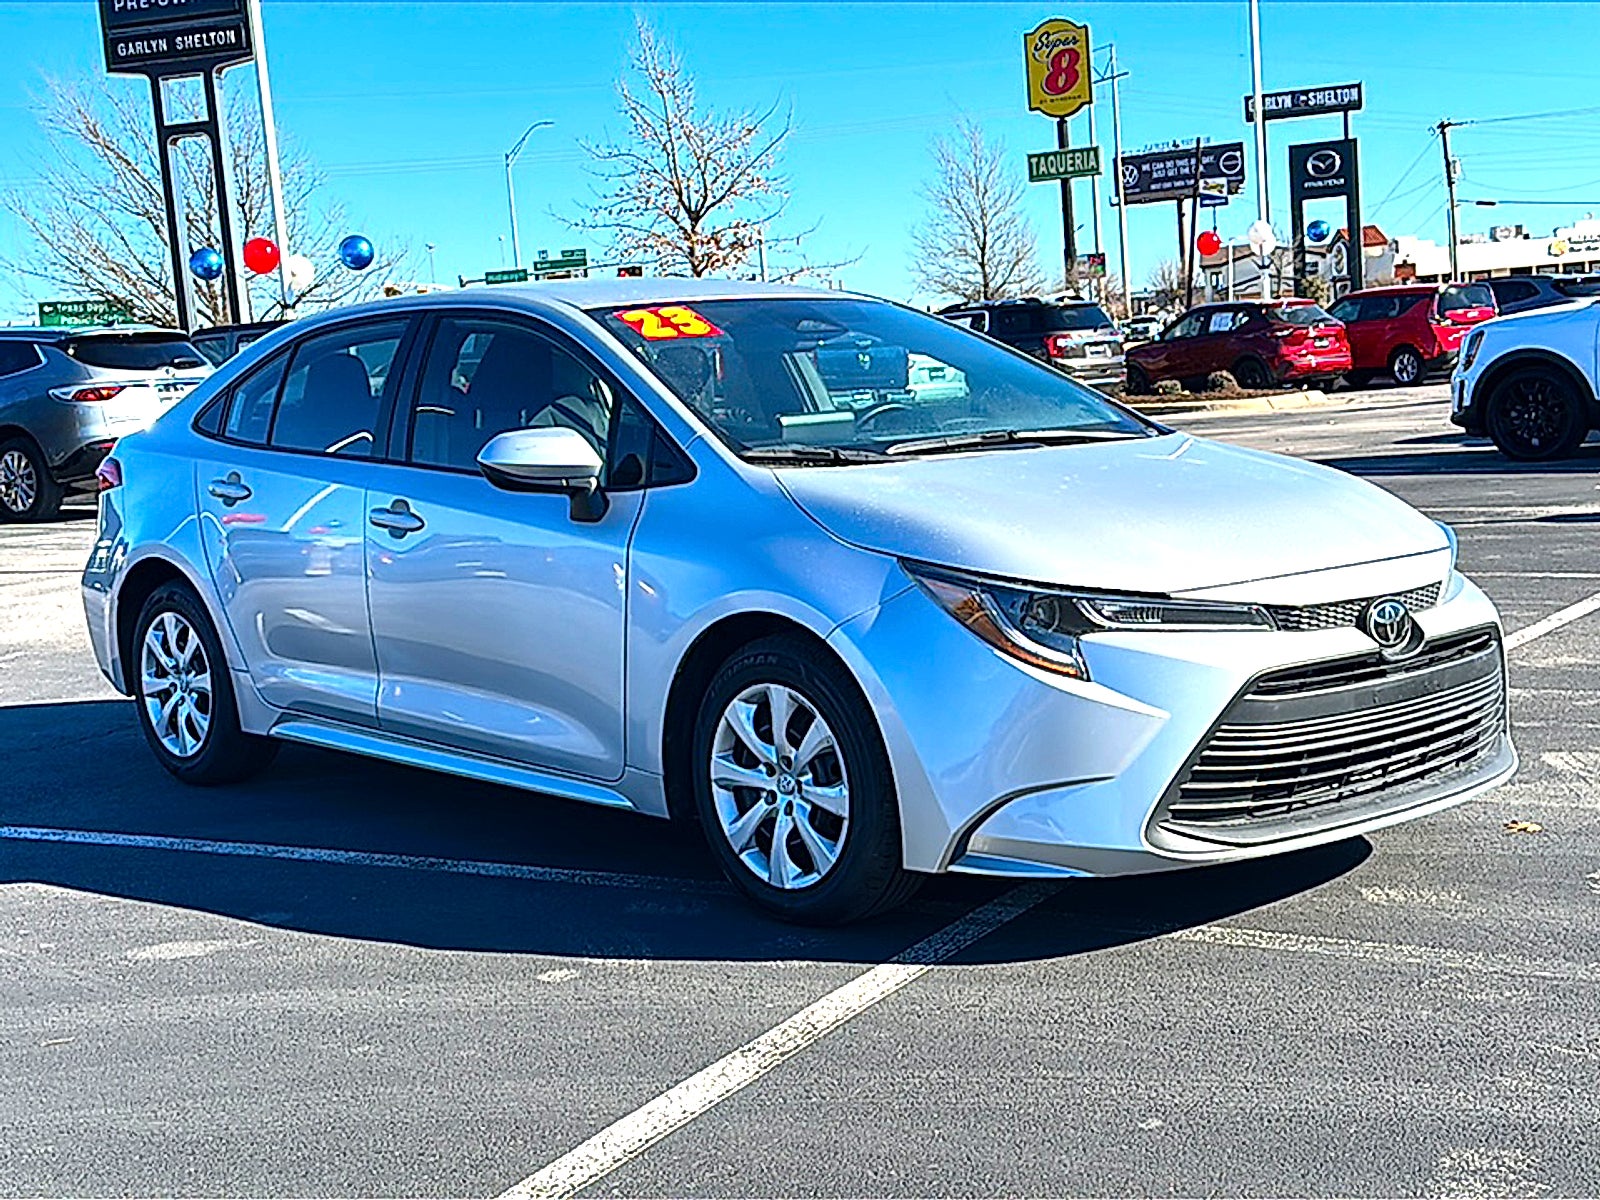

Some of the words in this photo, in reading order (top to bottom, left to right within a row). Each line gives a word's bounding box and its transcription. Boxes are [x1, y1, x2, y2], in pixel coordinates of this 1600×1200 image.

[117, 38, 168, 57] GARLYN
[175, 30, 236, 50] SHELTON
[1034, 29, 1079, 58] Super
[1043, 48, 1081, 95] 8
[1308, 87, 1358, 106] SHELTON
[1030, 150, 1098, 176] TAQUERIA
[622, 306, 711, 338] 23
